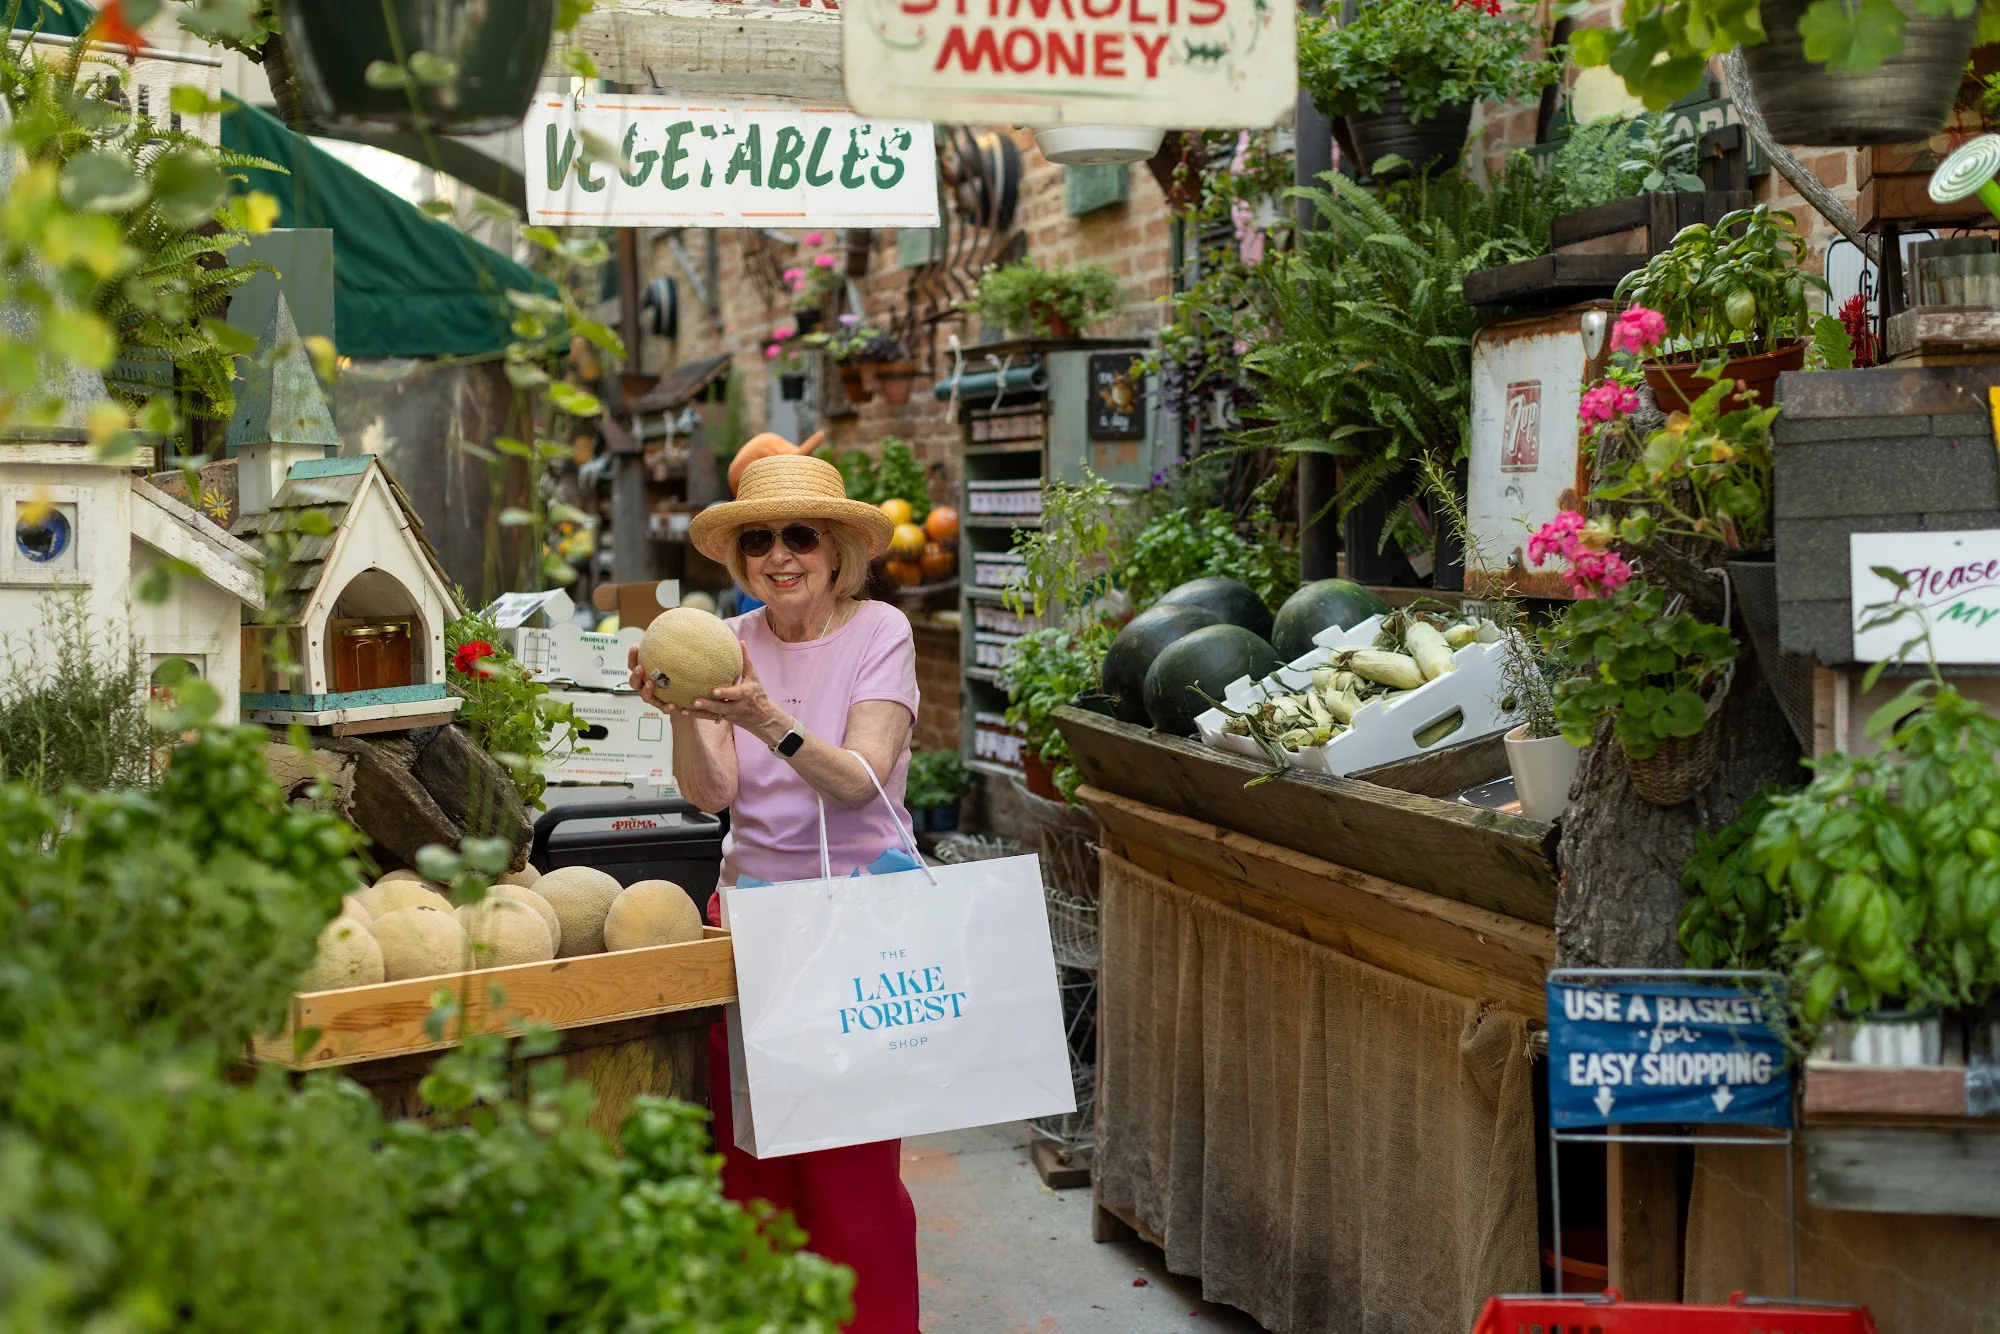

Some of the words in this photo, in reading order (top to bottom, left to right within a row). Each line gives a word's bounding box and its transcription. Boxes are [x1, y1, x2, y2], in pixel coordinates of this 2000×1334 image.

[933, 26, 1170, 79] MONEY
[545, 120, 913, 193] VEGETABLES
[1894, 559, 2000, 604] Please
[580, 636, 609, 644] PRODUCE
[612, 818, 657, 830] PRIMA
[879, 948, 907, 960] THE
[852, 966, 945, 1003] LAKE
[838, 992, 966, 1034] FOREST
[1564, 989, 1622, 1021] USE
[1626, 995, 1650, 1022] A
[1656, 996, 1766, 1024] BASKET
[889, 1036, 928, 1050] SHOP
[1569, 1052, 1638, 1085] EASY
[1641, 1051, 1773, 1086] SHOPPING
